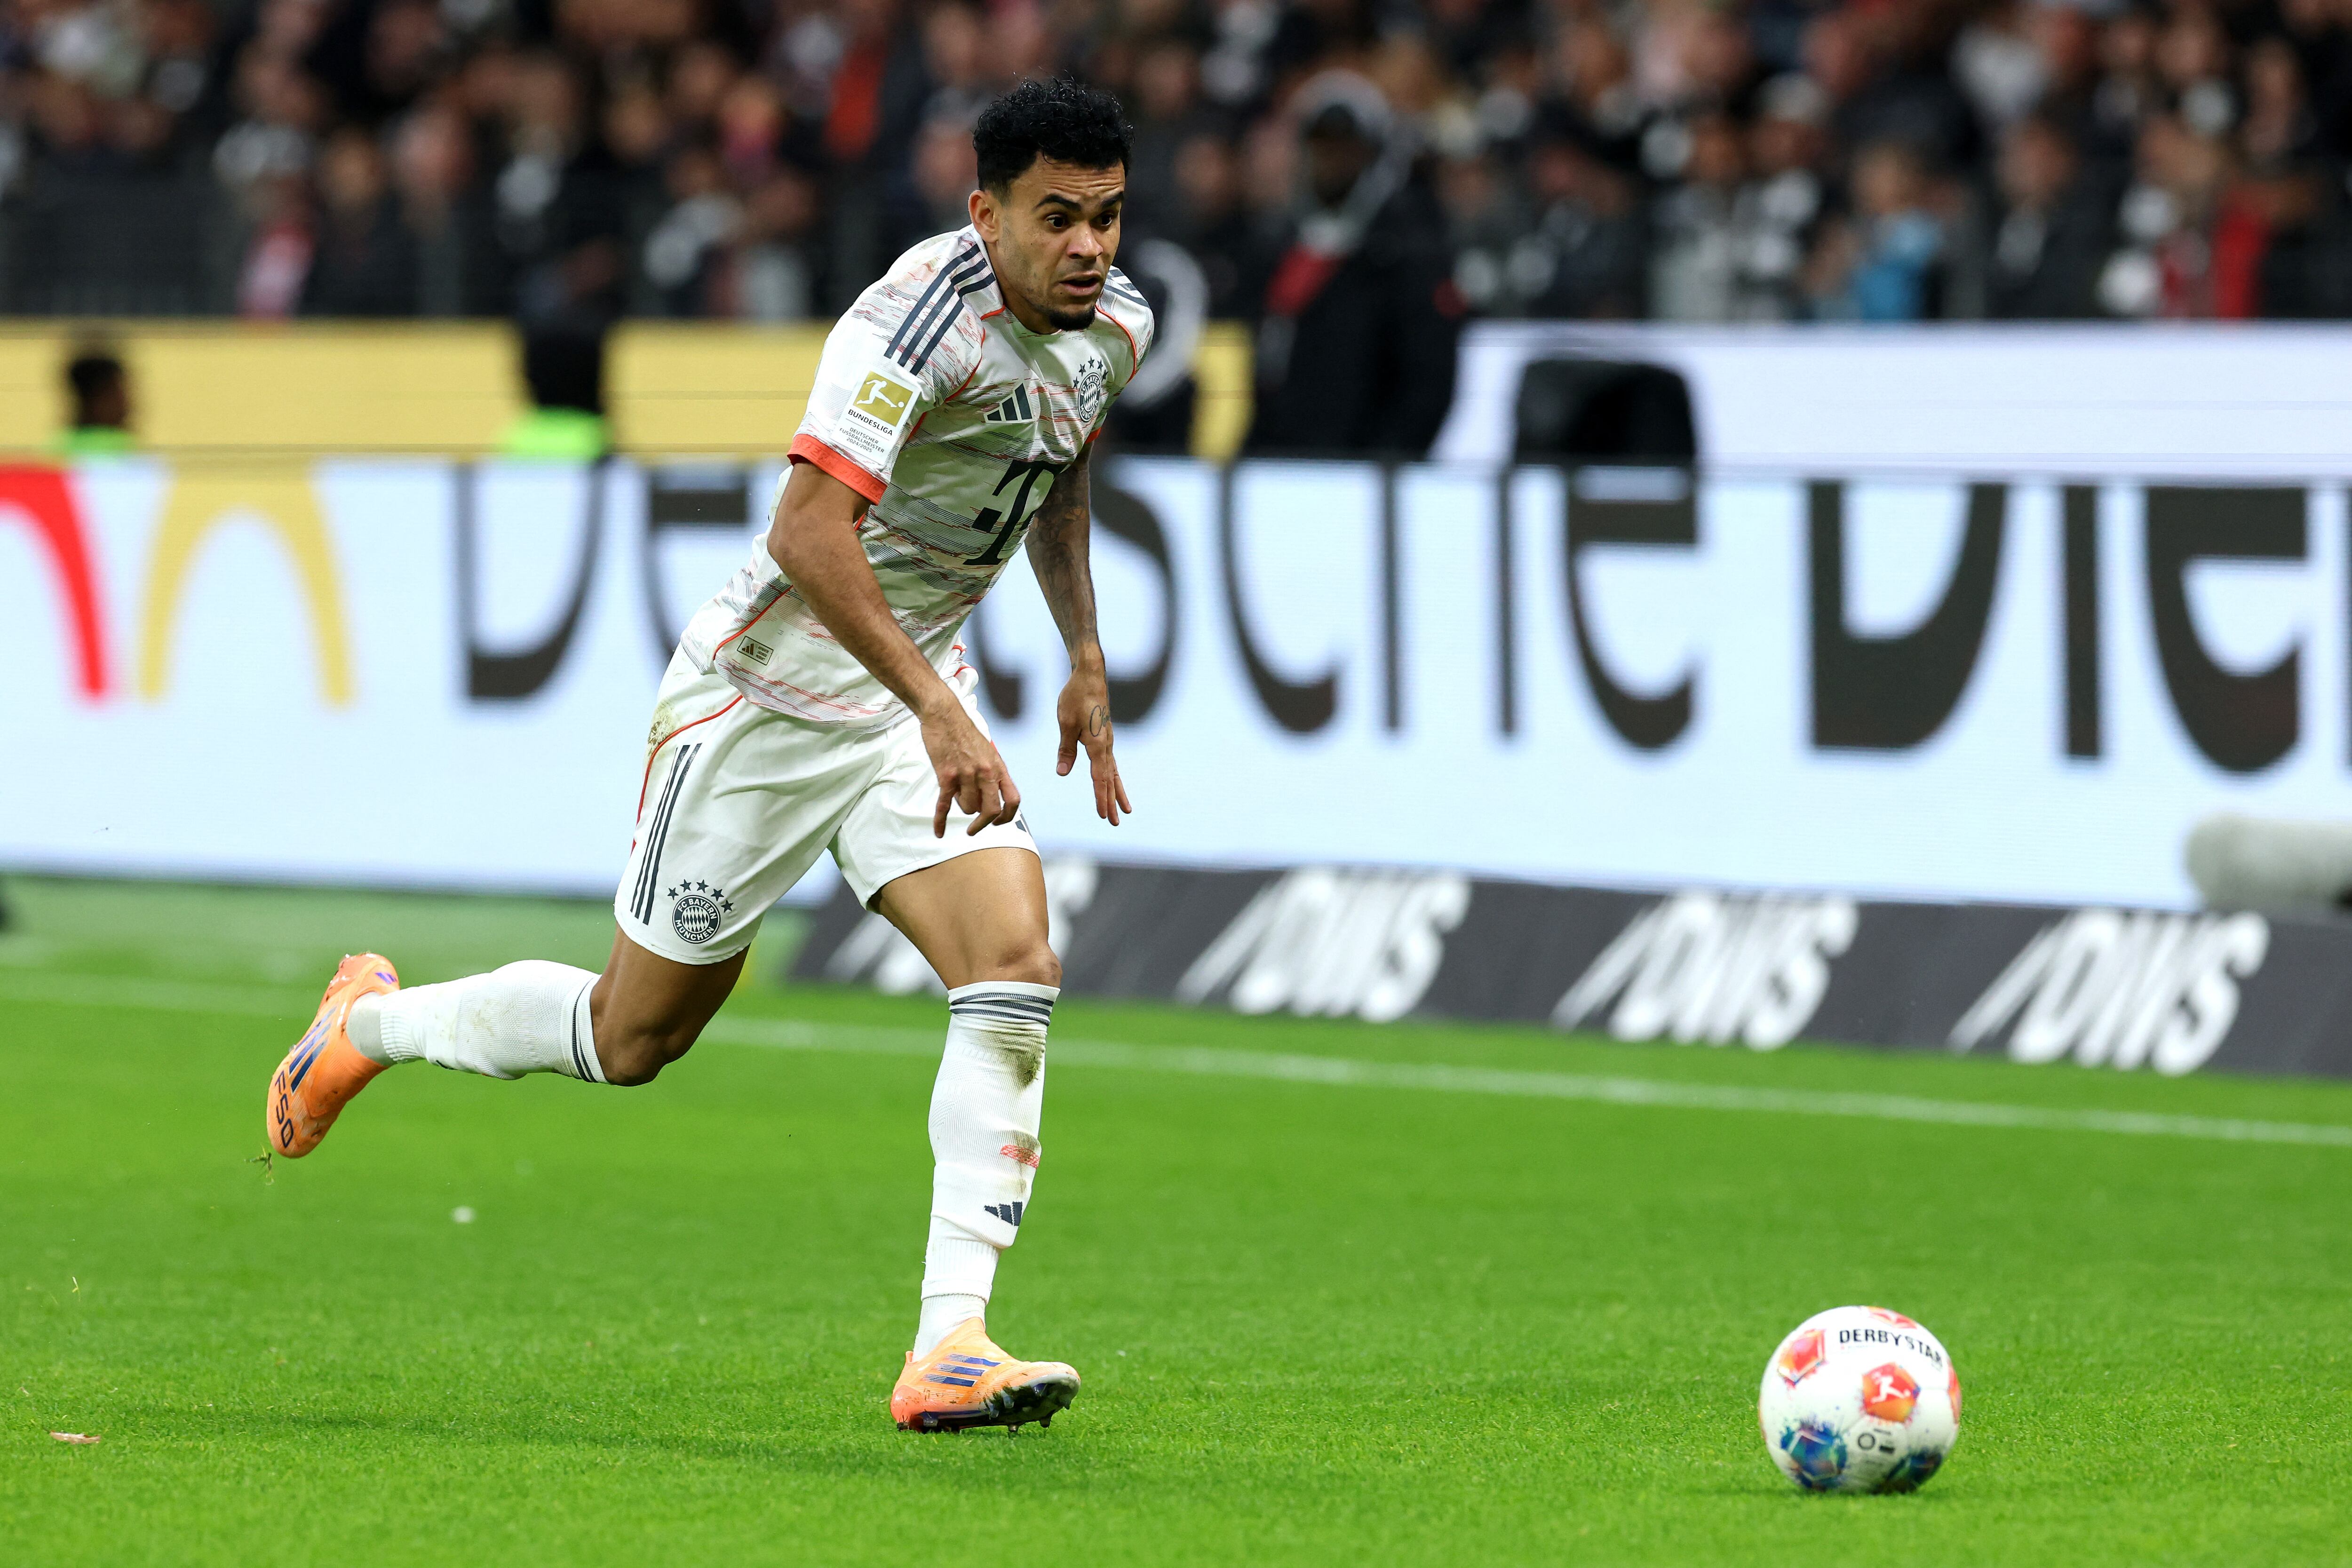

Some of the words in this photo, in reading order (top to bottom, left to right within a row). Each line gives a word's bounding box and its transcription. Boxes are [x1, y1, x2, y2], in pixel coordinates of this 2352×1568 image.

[1081, 385, 1087, 396] FC
[1086, 375, 1101, 391] BAYERN
[848, 409, 893, 436] BUNDESLIGA
[839, 428, 884, 453] FUSSBALLMEISTER
[846, 437, 873, 453] 2024/2025
[850, 427, 879, 444] DEUTSCHER
[677, 901, 687, 912] FC
[688, 899, 717, 919] BAYERN
[675, 919, 715, 940] MÜNCHEN
[275, 1070, 294, 1148] F50
[1839, 1329, 1942, 1365] DERBYSTAR
